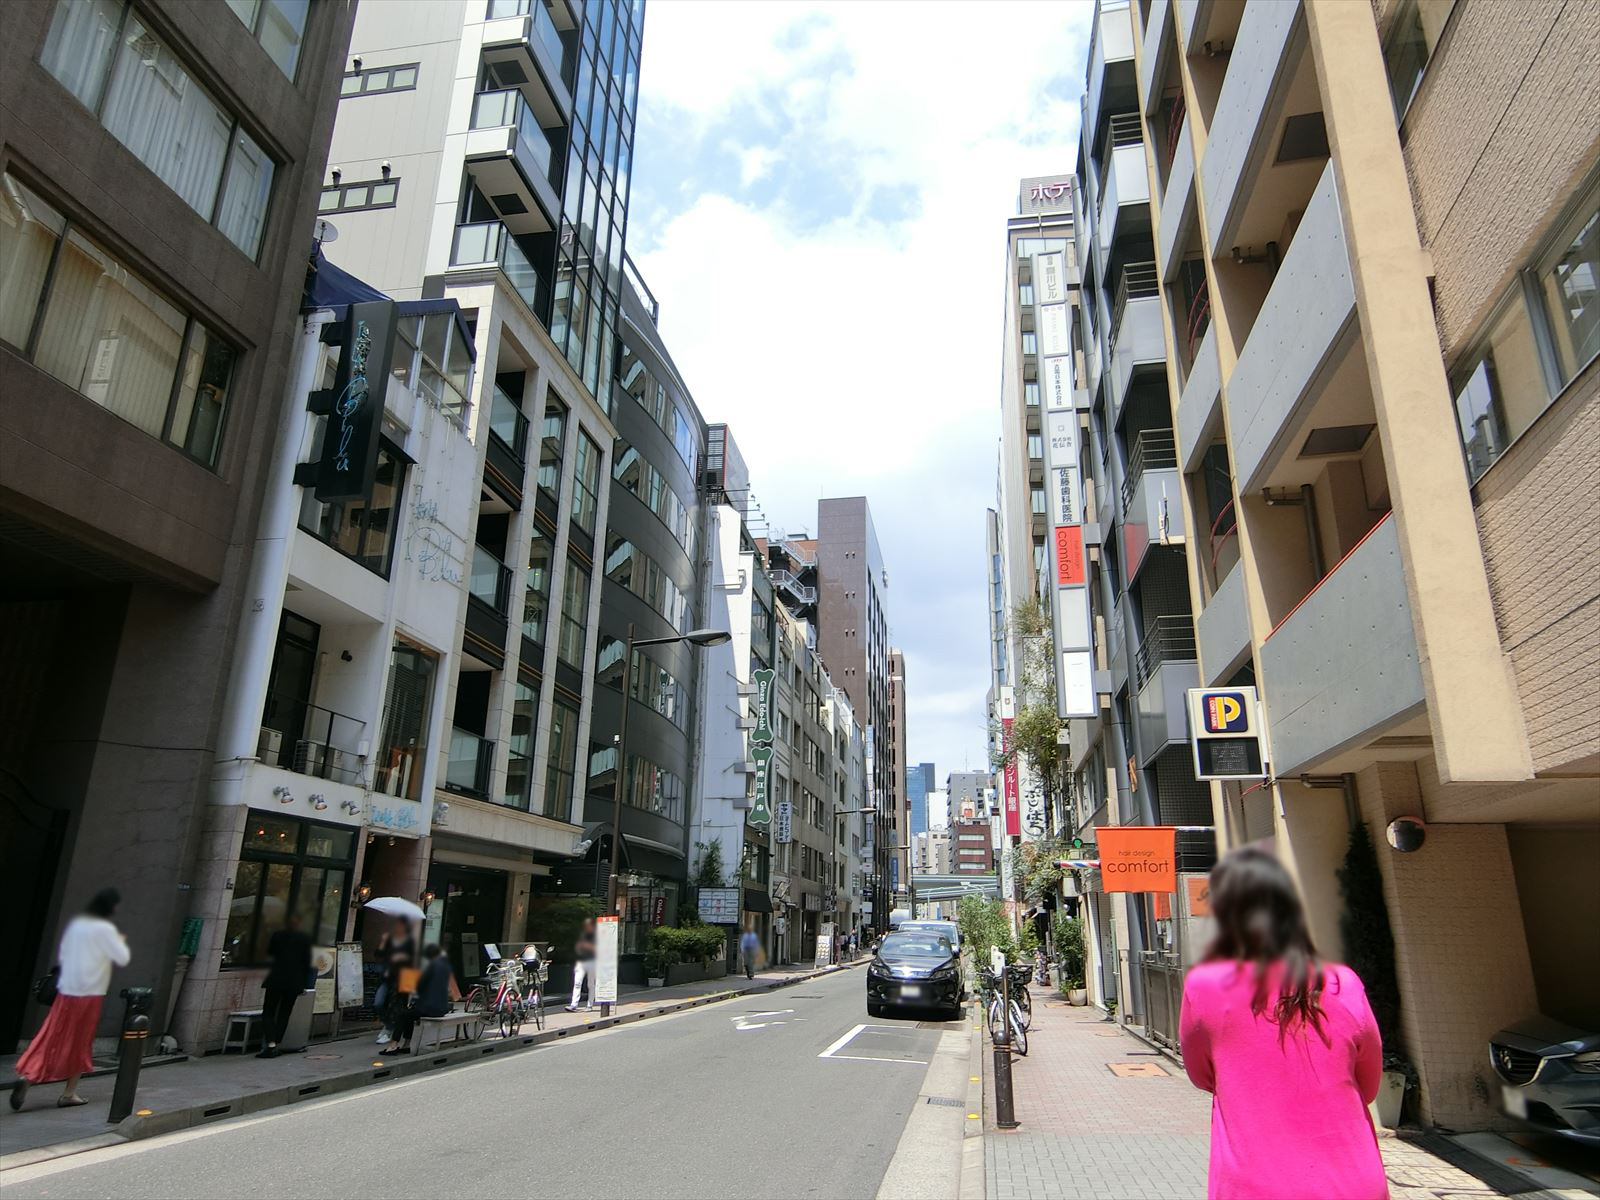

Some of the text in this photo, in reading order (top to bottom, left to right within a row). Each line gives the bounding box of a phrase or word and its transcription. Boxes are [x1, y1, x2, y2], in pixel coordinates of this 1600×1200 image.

[1030, 181, 1072, 200] ホテ
[1059, 468, 1073, 523] 佐藤歯科医院
[1058, 530, 1072, 580] comfort
[759, 680, 767, 702] Ginza
[1133, 850, 1155, 858] design
[1107, 860, 1169, 873] comfort
